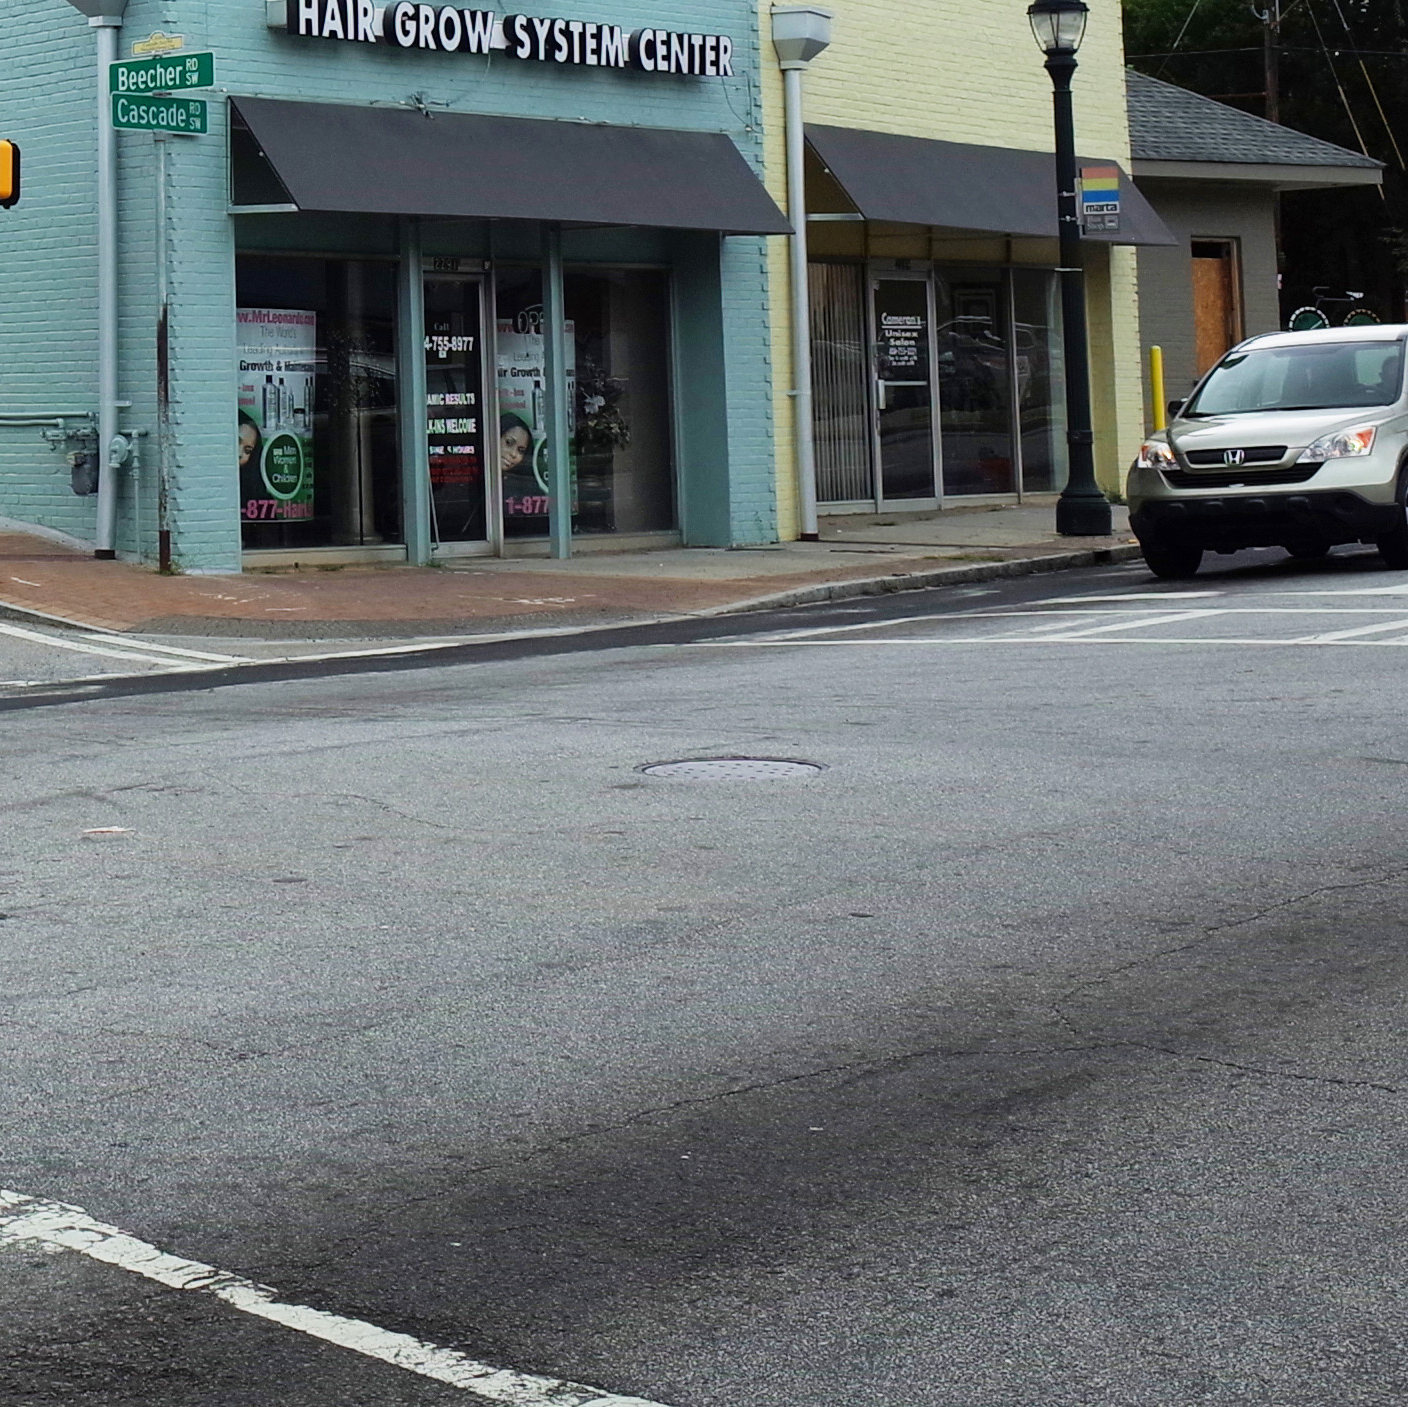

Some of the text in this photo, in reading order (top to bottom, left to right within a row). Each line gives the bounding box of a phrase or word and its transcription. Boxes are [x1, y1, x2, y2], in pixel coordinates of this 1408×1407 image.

[394, 1, 495, 54] GROW
[514, 14, 625, 68] SYSTEM
[638, 28, 734, 76] CENTER
[186, 58, 198, 71] RD
[118, 64, 183, 91] Beecher
[186, 72, 199, 85] SW
[117, 99, 186, 127] Cascade
[189, 102, 201, 115] RD
[189, 117, 201, 129] SW
[1085, 203, 1117, 212] marta
[885, 330, 918, 338] Unisex
[889, 338, 916, 346] Salon
[239, 360, 274, 371] Growth
[276, 361, 283, 371] &
[510, 367, 541, 377] Growth
[445, 393, 475, 405] RESULTS
[446, 418, 477, 433] WELCOME
